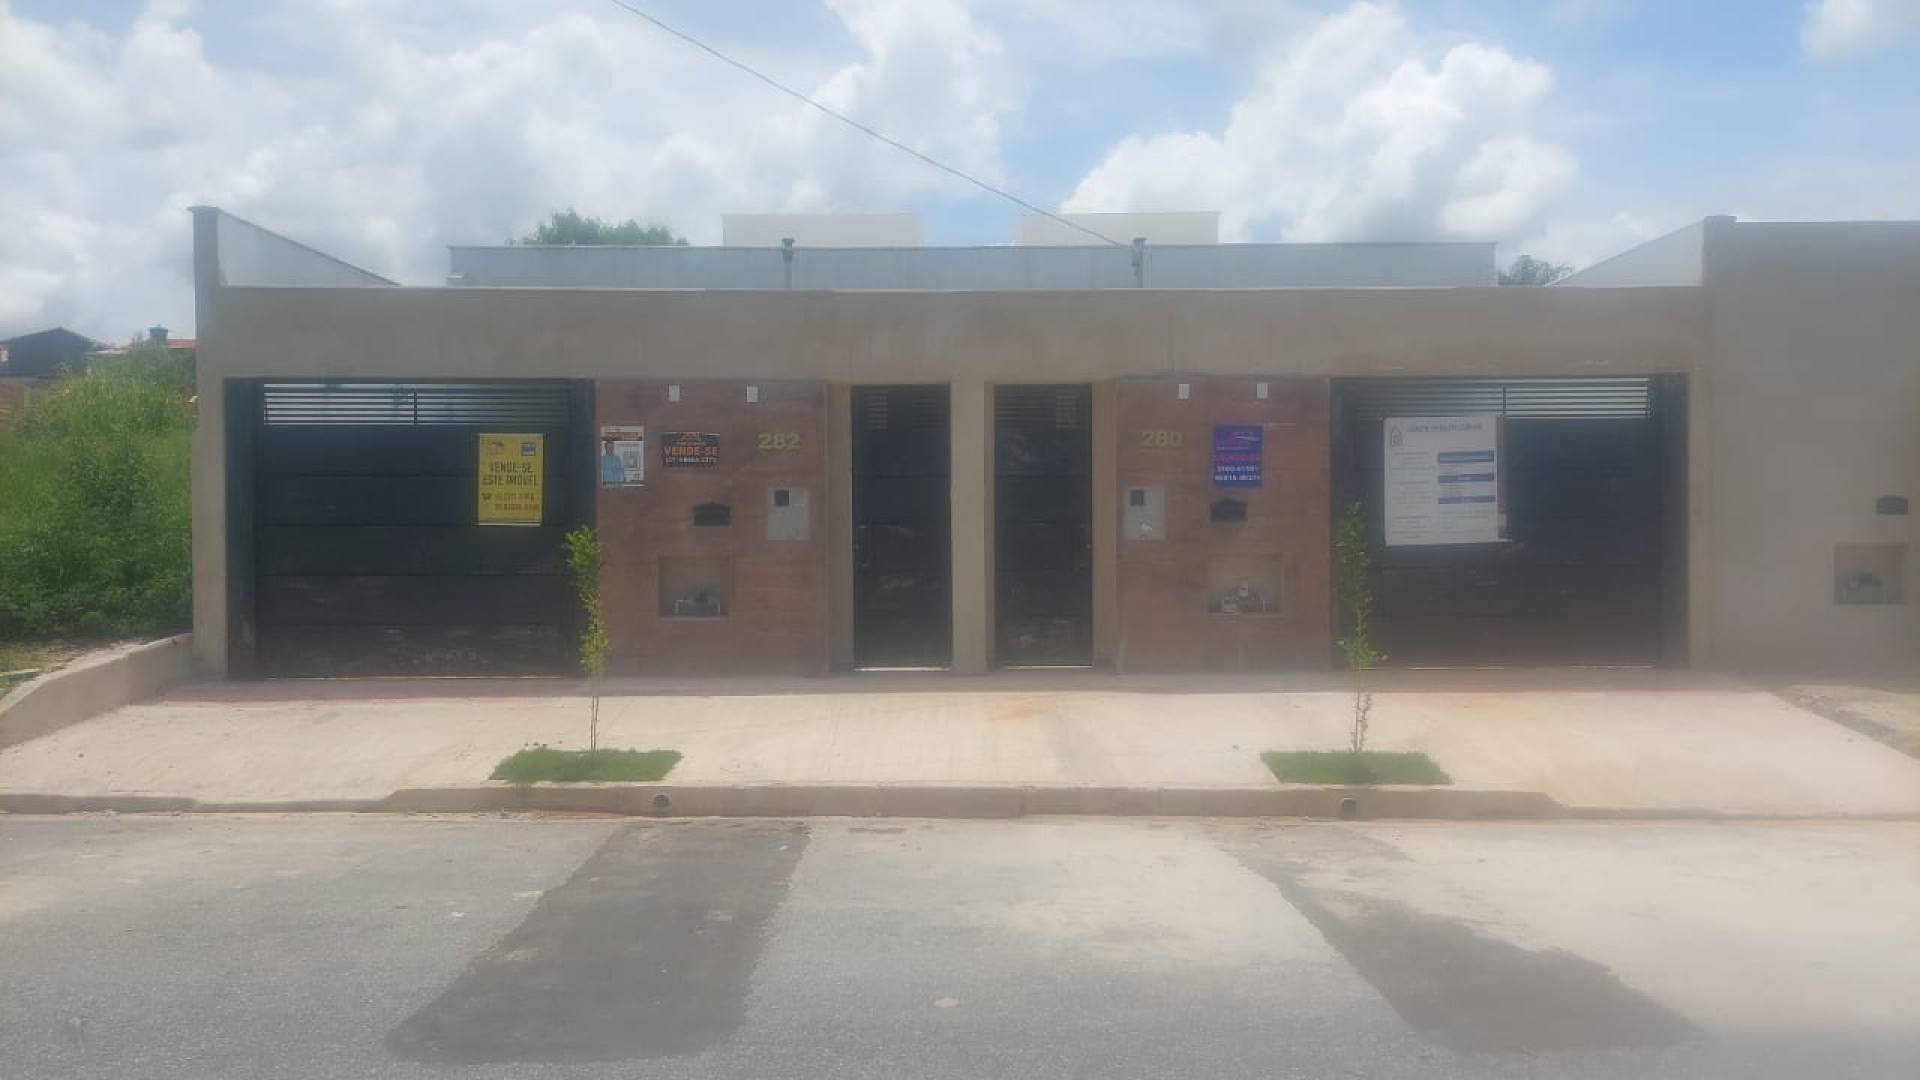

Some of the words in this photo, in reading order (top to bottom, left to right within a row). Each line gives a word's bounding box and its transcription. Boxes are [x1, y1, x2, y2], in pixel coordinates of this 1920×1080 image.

[758, 432, 800, 449] 282
[1140, 432, 1183, 448] 280
[663, 446, 719, 457] VENDE-SE
[481, 474, 504, 486] ESTE
